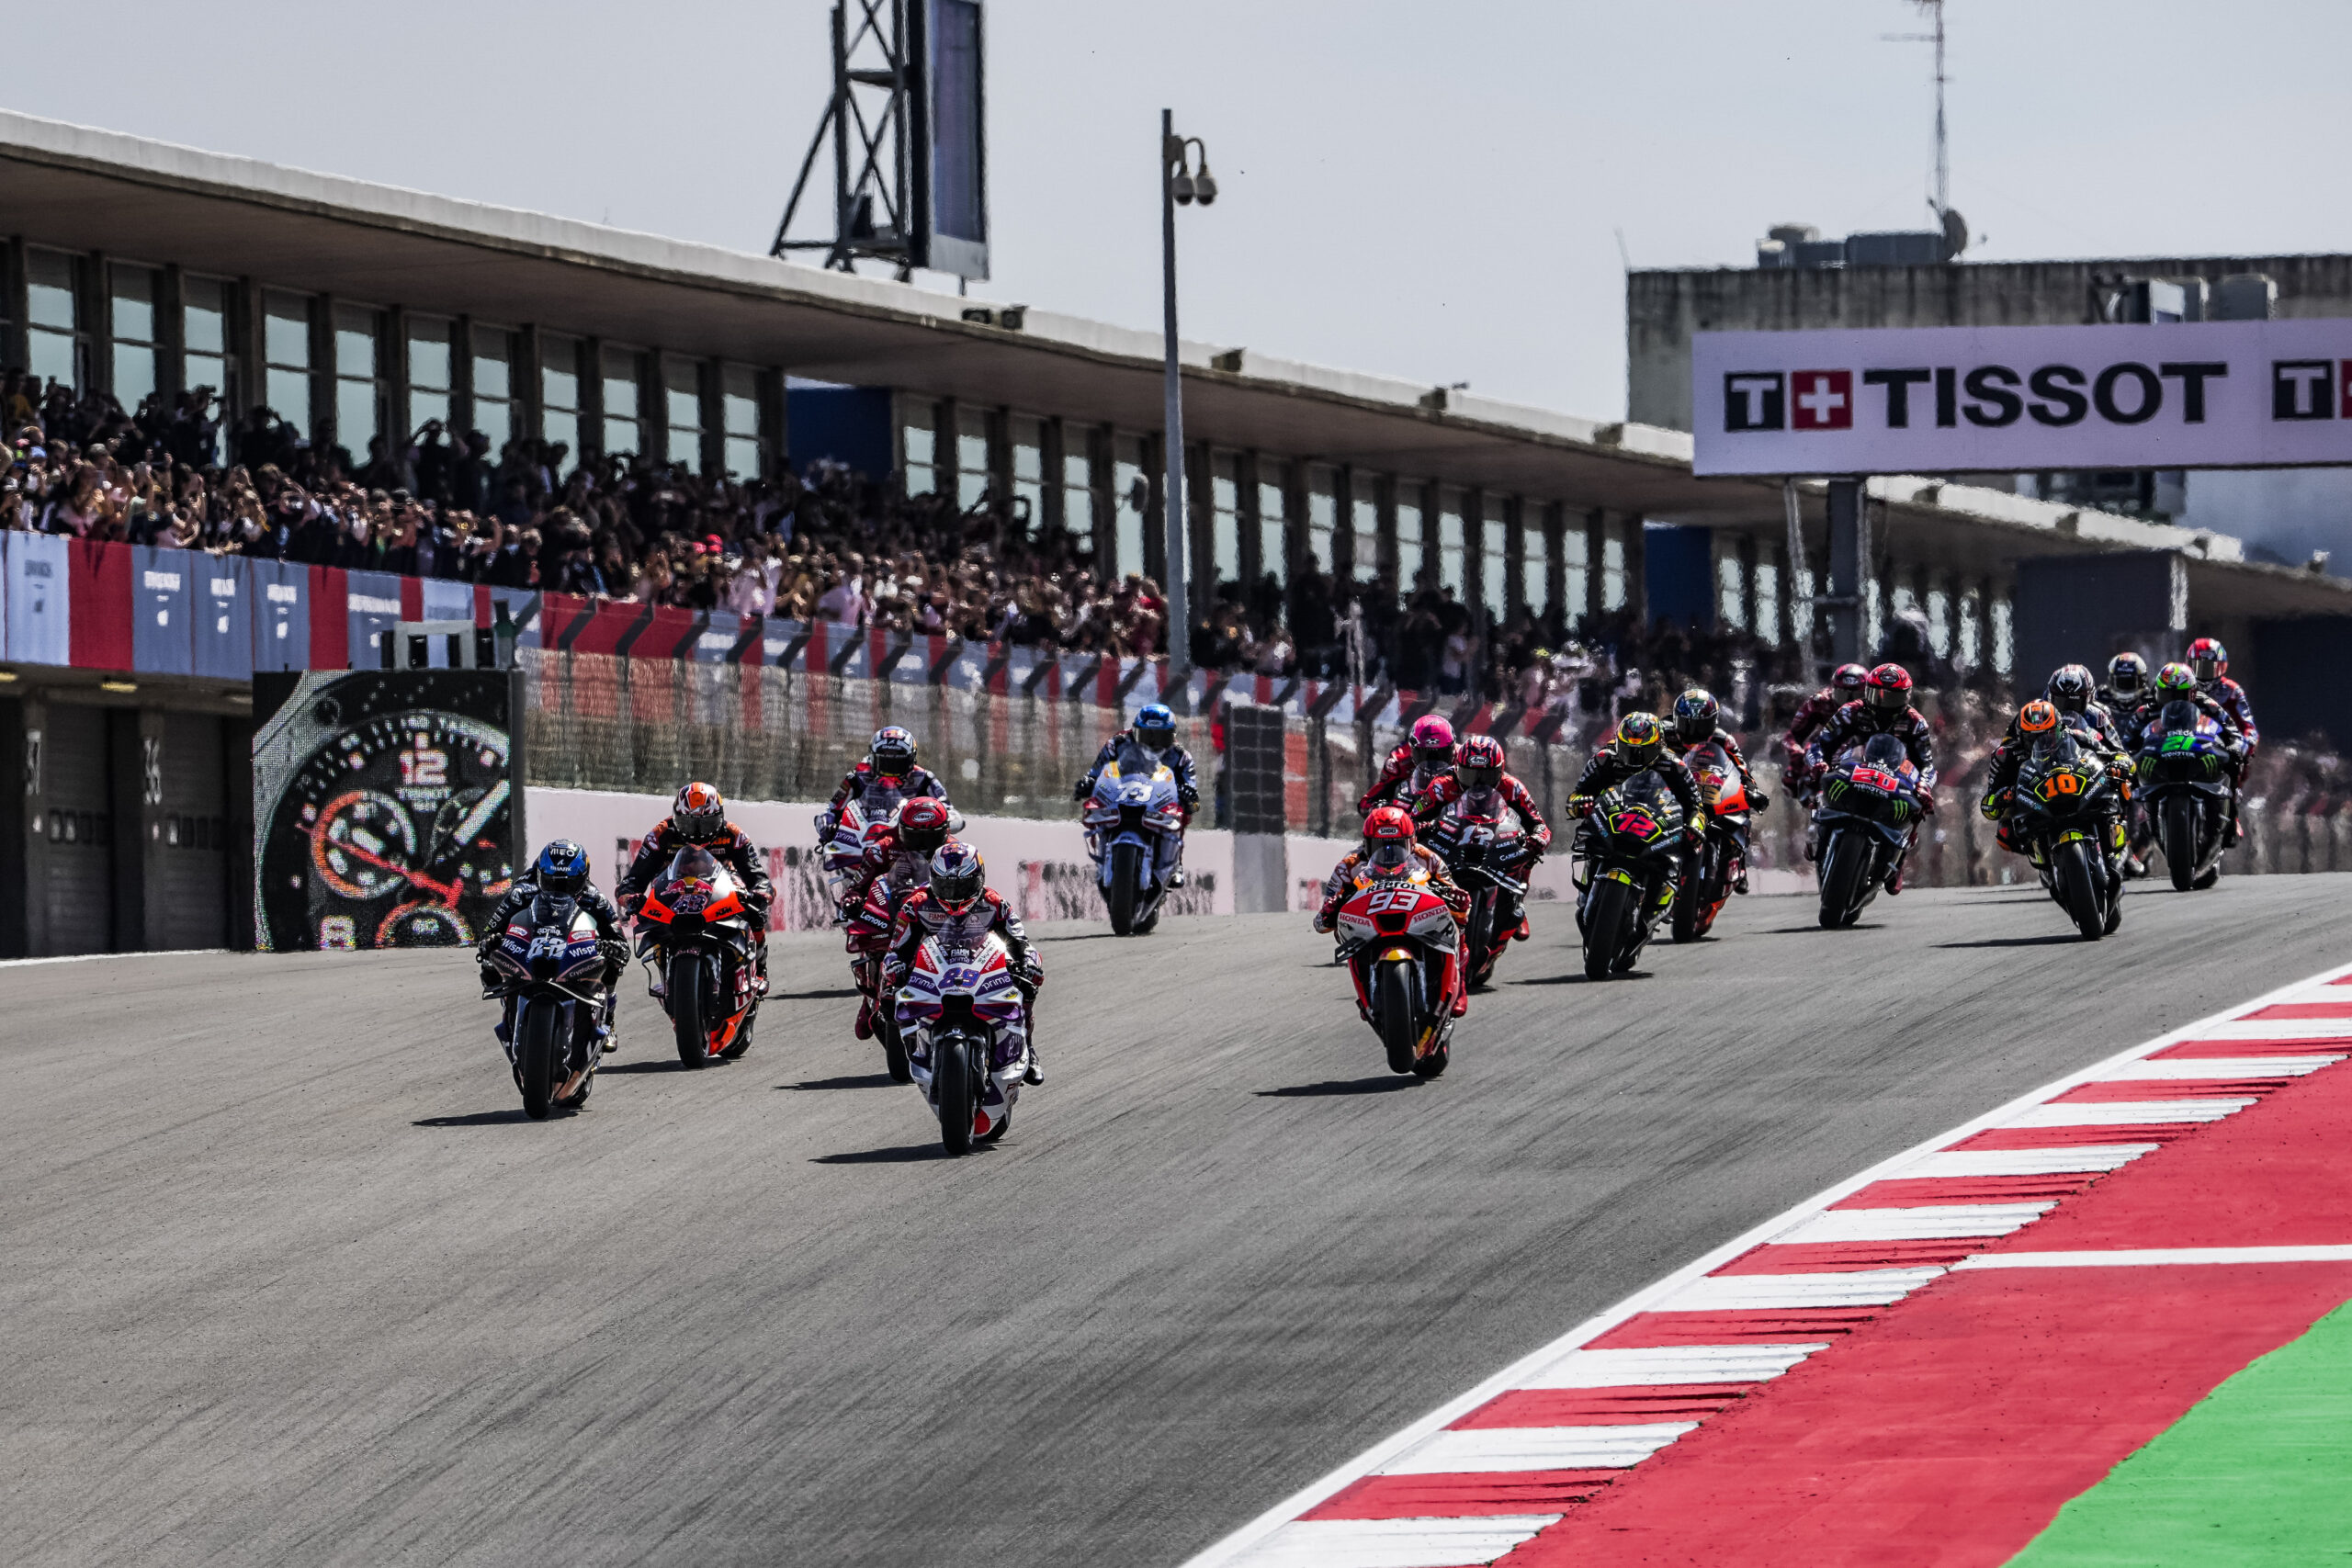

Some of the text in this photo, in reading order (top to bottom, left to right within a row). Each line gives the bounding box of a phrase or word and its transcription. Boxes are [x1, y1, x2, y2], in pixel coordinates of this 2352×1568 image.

[1862, 361, 2228, 429] TISSOT
[2161, 735, 2197, 751] 21
[399, 750, 448, 784] 12
[1471, 756, 1487, 764] Arai
[1867, 761, 1894, 776] ENEOS
[1115, 781, 1154, 803] 73
[1854, 783, 1889, 798] MONSTER
[2044, 773, 2077, 798] 10
[1617, 813, 1657, 838] 72
[835, 830, 858, 843] prima
[670, 894, 708, 915] 43
[1366, 889, 1421, 916] 93
[648, 908, 662, 919] KTM
[715, 907, 732, 918] KTM
[860, 910, 888, 930] Lenovo
[1339, 913, 1372, 927] HONDA
[1413, 906, 1449, 923] HONDA
[503, 938, 526, 954] Wispr
[569, 945, 596, 958] Wispr
[950, 948, 970, 956] FIAMM
[919, 948, 935, 971] PRAMAC
[949, 956, 970, 964] prima
[909, 976, 935, 989] prima
[938, 967, 980, 989] 89
[981, 976, 1011, 991] prima
